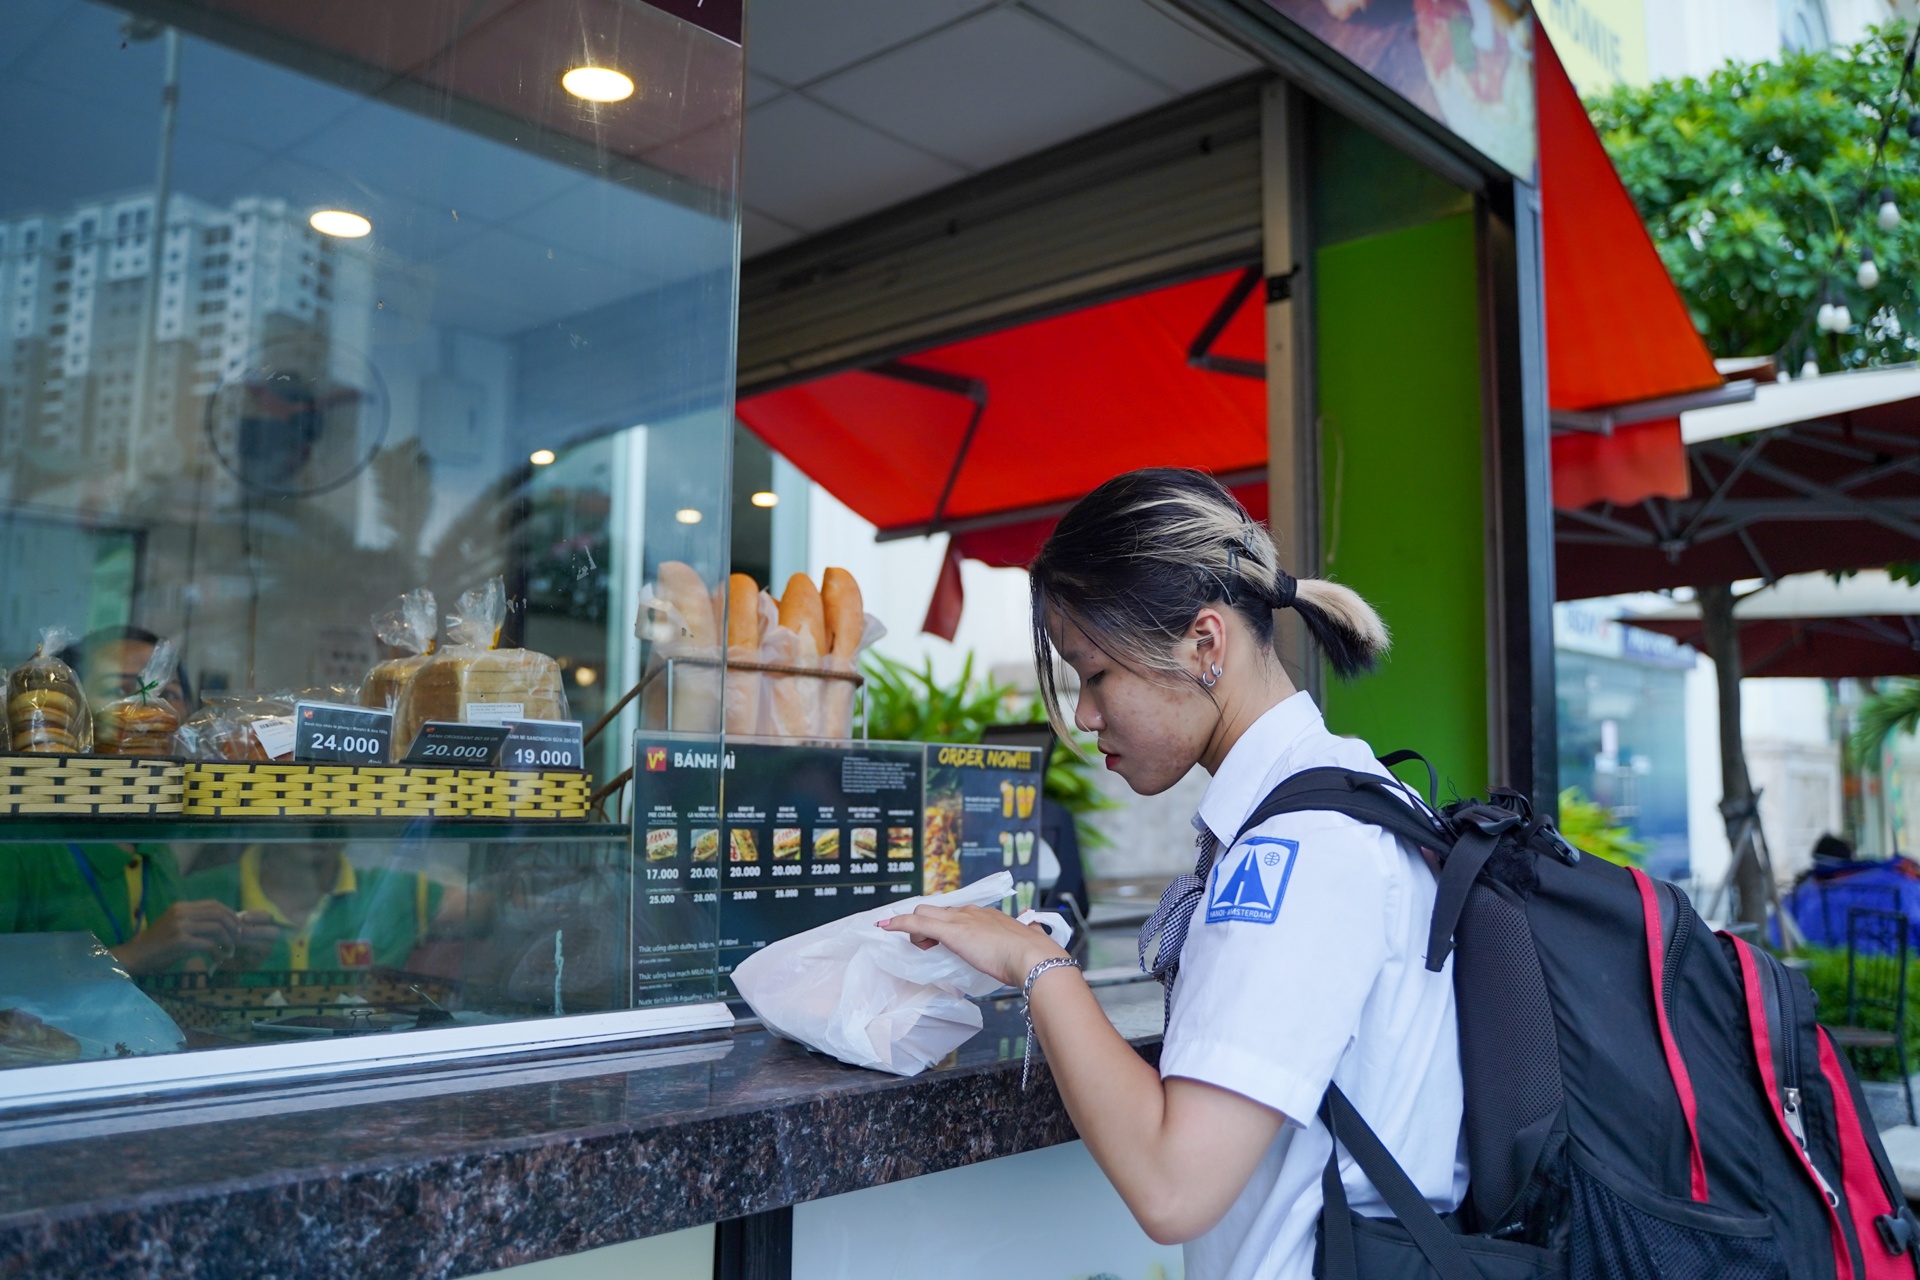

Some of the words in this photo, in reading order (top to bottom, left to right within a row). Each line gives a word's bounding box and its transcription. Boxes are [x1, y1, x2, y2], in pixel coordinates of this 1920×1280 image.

[311, 733, 380, 754] 24.000
[422, 744, 488, 758] 20.000
[515, 748, 572, 766] 19.000
[674, 749, 717, 769] BÁNH
[938, 747, 985, 769] ORDER
[646, 868, 679, 880] 17.000
[690, 867, 718, 879] 20.00
[730, 866, 761, 877] 20.000
[772, 865, 802, 876] 20.000
[811, 864, 840, 875] 22.000
[850, 862, 879, 874] 26.000
[649, 895, 675, 904] 25.000
